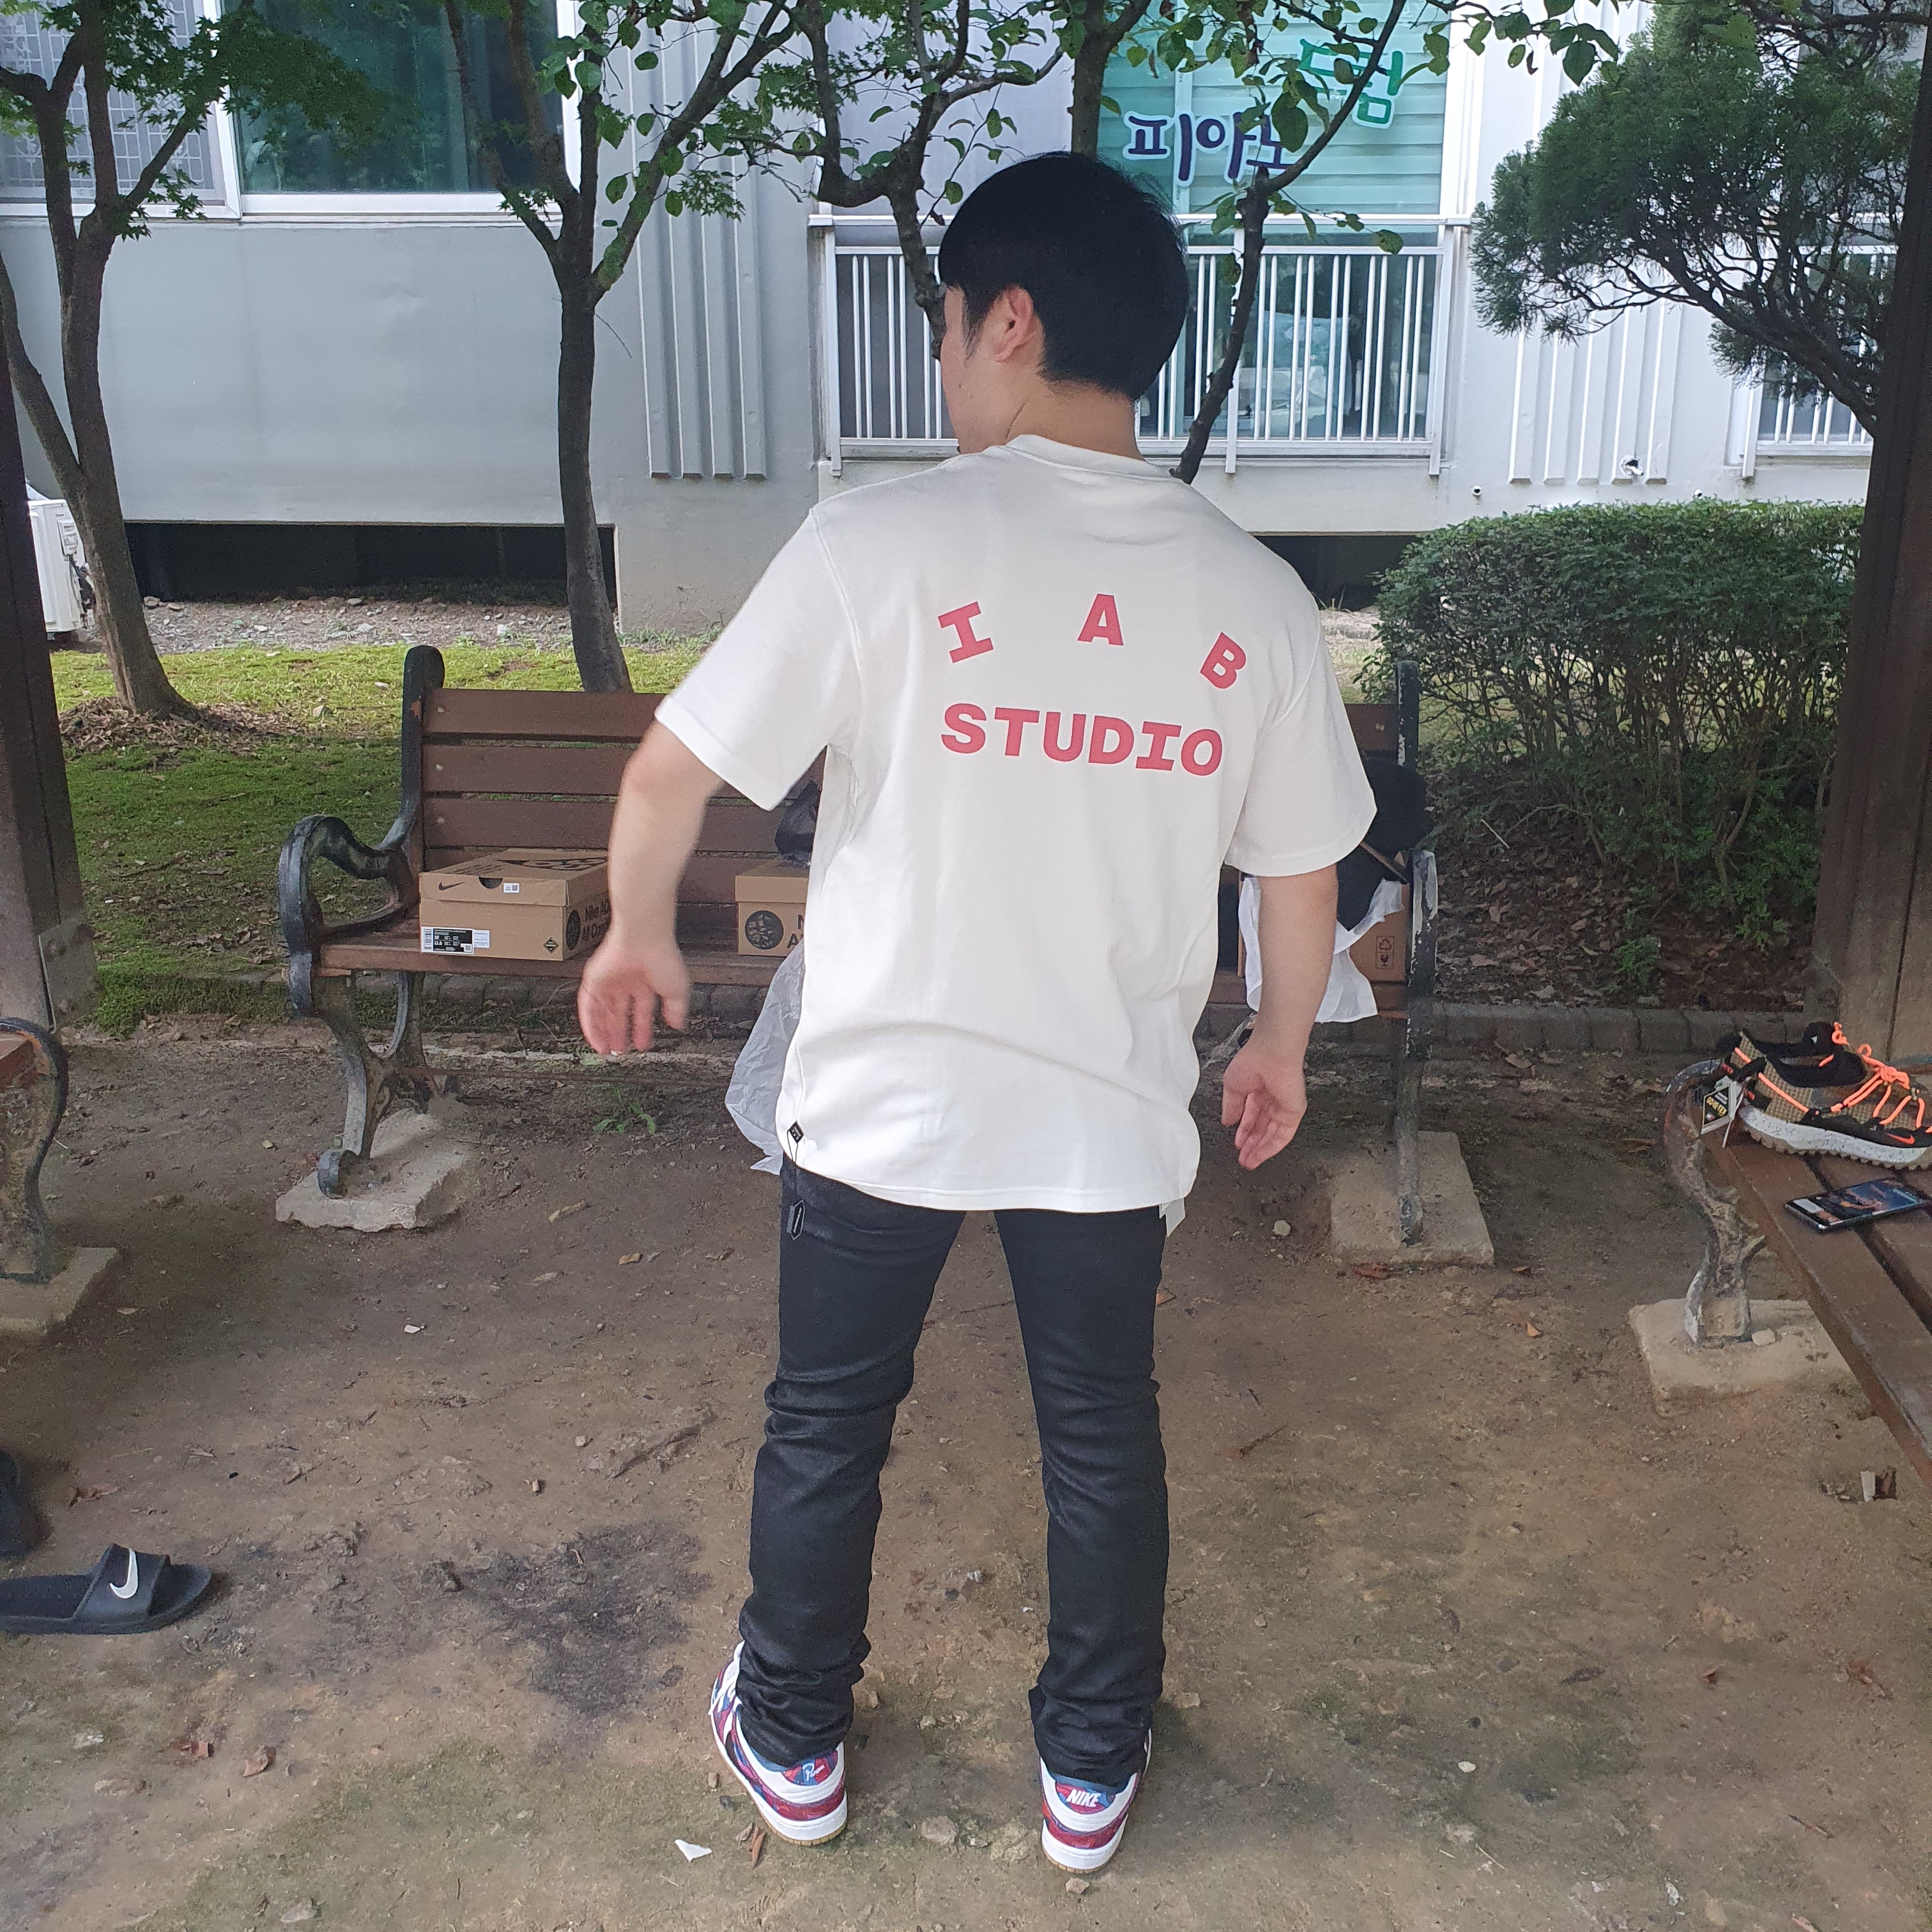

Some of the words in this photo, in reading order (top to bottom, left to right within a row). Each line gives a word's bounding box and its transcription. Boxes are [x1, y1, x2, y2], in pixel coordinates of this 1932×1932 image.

[1127, 112, 1300, 181] 피아노
[941, 703, 1223, 776] STUDIO
[1066, 1788, 1101, 1807] NIKE
